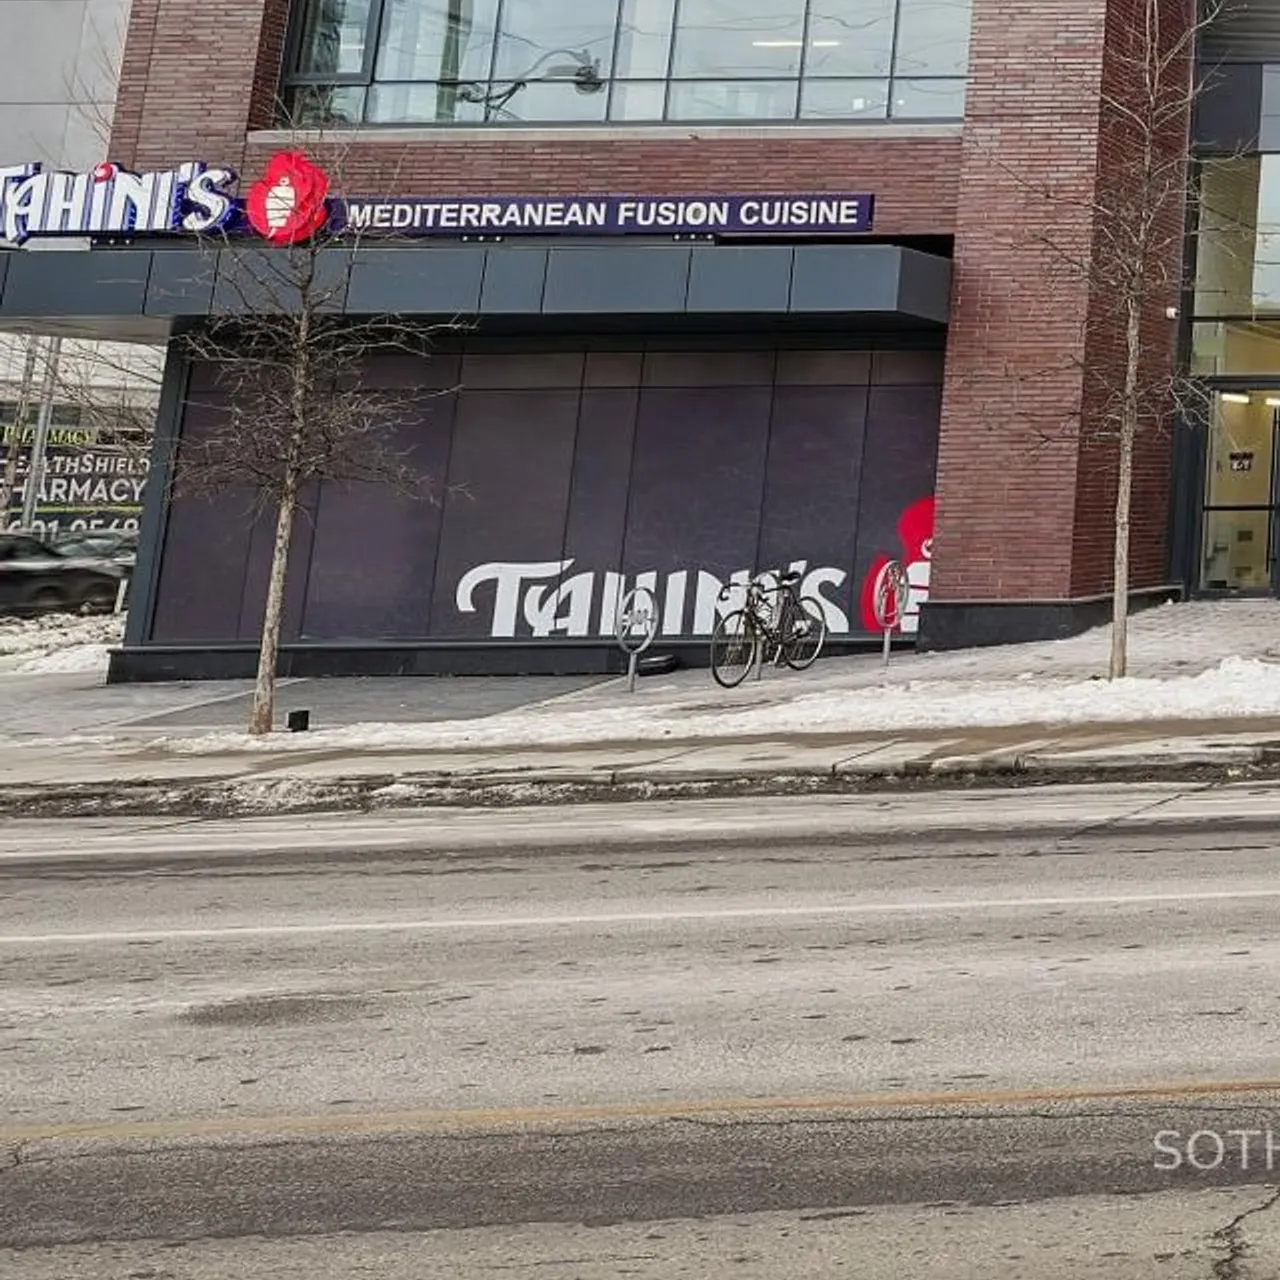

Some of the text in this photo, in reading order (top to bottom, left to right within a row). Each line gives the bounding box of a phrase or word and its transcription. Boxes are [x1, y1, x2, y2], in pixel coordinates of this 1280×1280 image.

[347, 200, 858, 228] MEDITERRANEAN FUSION CUISINE
